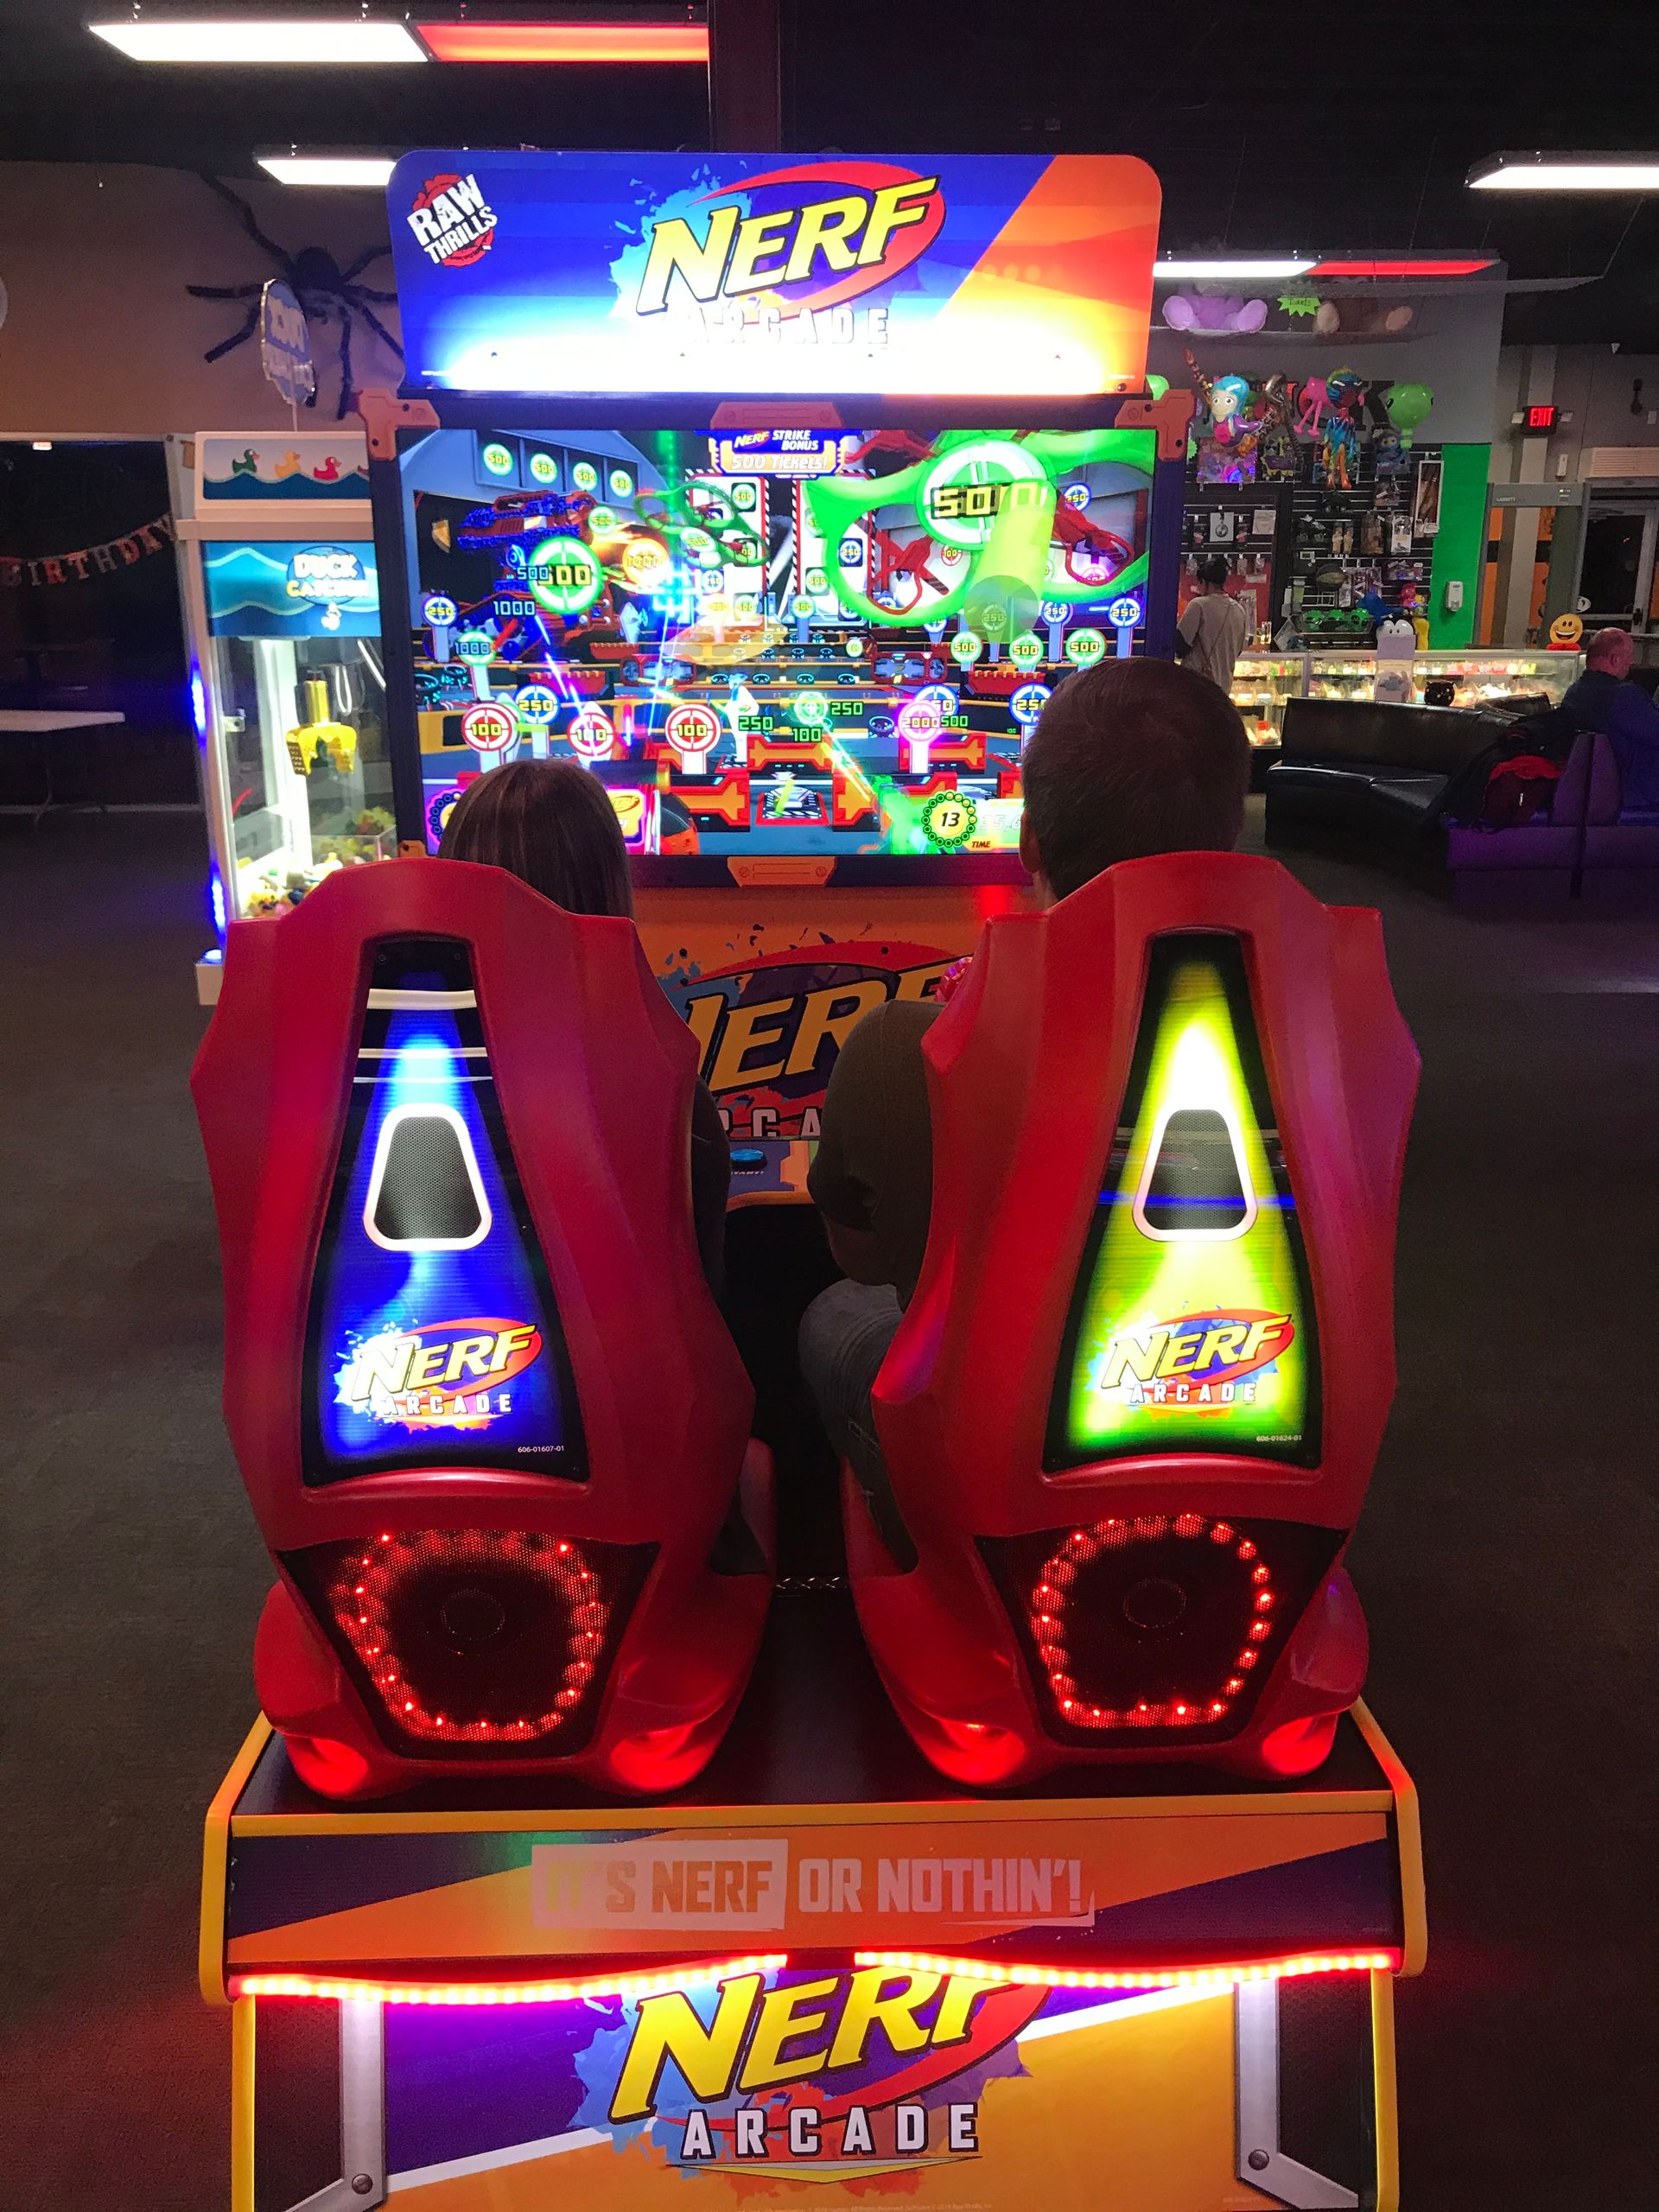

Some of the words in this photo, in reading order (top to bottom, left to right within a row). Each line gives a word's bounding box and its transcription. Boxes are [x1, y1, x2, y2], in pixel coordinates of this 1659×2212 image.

[406, 173, 486, 246] RAW
[423, 206, 498, 264] THRILLS
[636, 174, 942, 316] NERF
[684, 306, 889, 345] ARCADE
[1529, 407, 1554, 427] EXIT
[734, 431, 770, 448] NERF
[772, 429, 811, 441] STRIKE
[781, 440, 819, 451] BONUS
[488, 454, 510, 465] 500
[731, 454, 766, 469] 500
[535, 464, 554, 474] 500
[577, 473, 595, 481] 500
[613, 480, 630, 488] 500
[294, 553, 359, 579] DUCK
[517, 565, 550, 581] 500
[428, 607, 454, 616] 250
[493, 601, 536, 616] 1000
[1046, 607, 1065, 615] 250
[1111, 607, 1138, 617] 250
[454, 642, 492, 655] 1000
[953, 643, 976, 652] 500
[1013, 645, 1039, 655] 500
[1070, 642, 1100, 652] 500
[518, 699, 555, 712] 250
[830, 702, 863, 715] 250
[738, 716, 774, 731] 250
[901, 716, 941, 728] 2000
[941, 715, 969, 728] 500
[470, 723, 503, 736] 100
[575, 728, 607, 741] 100
[677, 723, 708, 737] 100
[792, 728, 822, 742] 100
[941, 812, 961, 827] 13
[1101, 1313, 1293, 1389] NERF
[351, 1323, 537, 1402] NERF
[1130, 1382, 1257, 1403] ARCADE
[383, 1392, 512, 1416] ARCADE
[517, 1445, 565, 1453] 606-01607-01
[650, 1859, 773, 1913] NERF
[798, 1858, 862, 1913] OR
[878, 1858, 1082, 1913] NOTHIN'!
[680, 2102, 980, 2160] ARCADE
